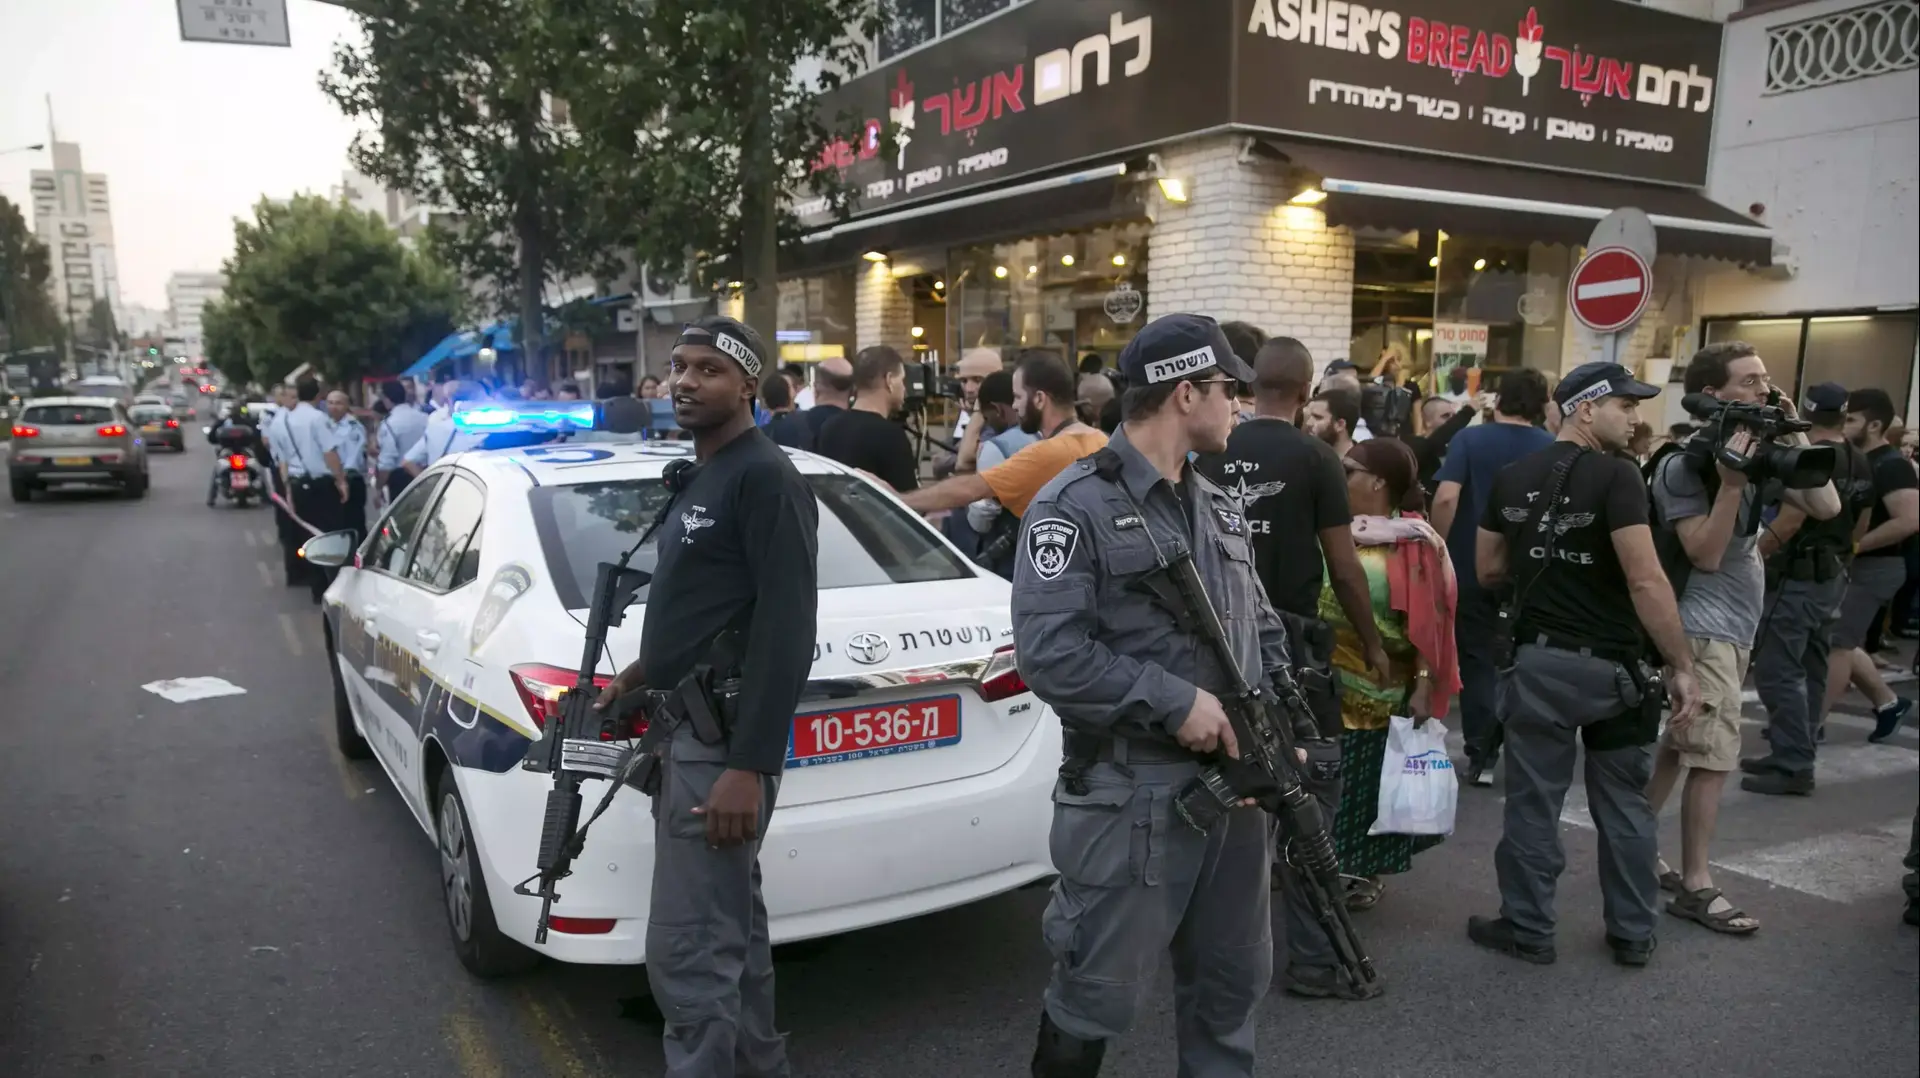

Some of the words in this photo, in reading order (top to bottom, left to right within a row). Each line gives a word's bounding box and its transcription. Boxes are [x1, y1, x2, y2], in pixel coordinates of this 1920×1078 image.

[1247, 0, 1401, 59] ASHER'S
[1407, 18, 1512, 79] BREAD
[1034, 11, 1152, 106] לחם
[1308, 78, 1402, 112] למהדרין
[1637, 64, 1713, 112] לחם
[1406, 94, 1460, 120] כשר
[1482, 106, 1526, 134] קפה
[1615, 128, 1674, 152] מאפיה
[867, 179, 894, 199] קפה
[721, 337, 758, 373] משטרה
[1154, 352, 1209, 377] משטרה
[1529, 546, 1593, 564] OLICE
[899, 625, 991, 651] משטרת
[848, 752, 863, 760] 100
[868, 748, 894, 757] ישראל
[1404, 759, 1428, 770] ABY
